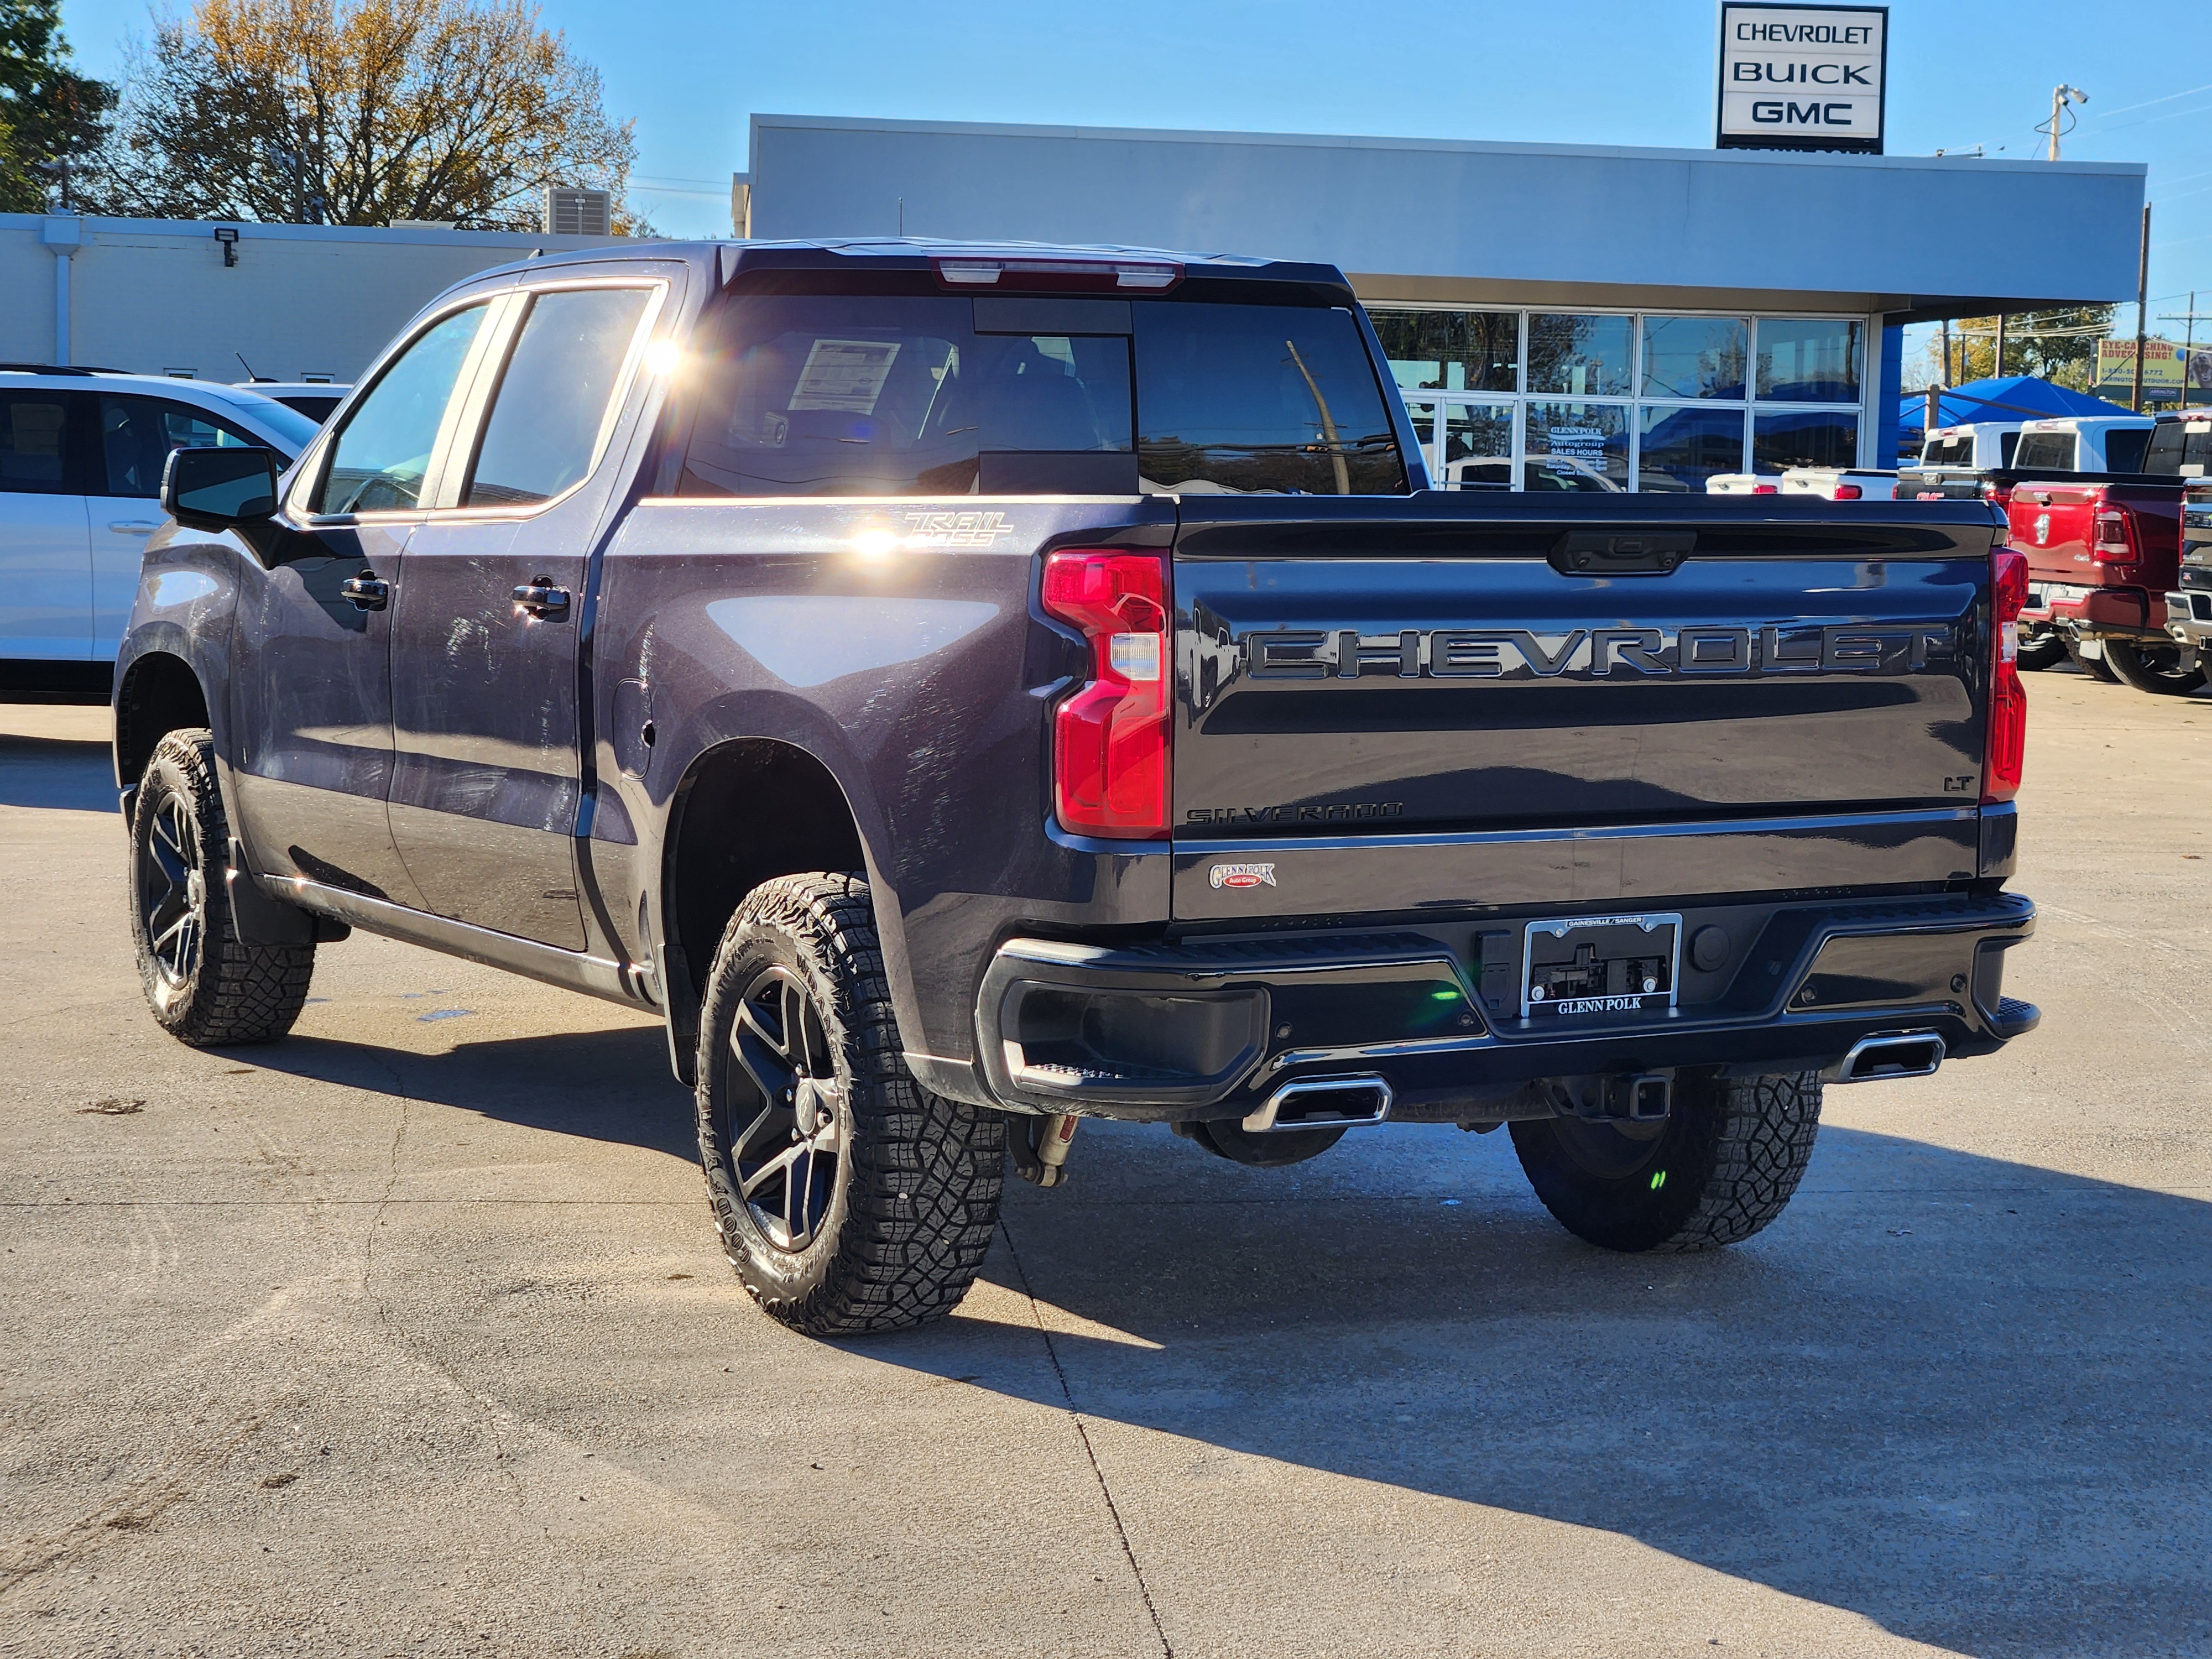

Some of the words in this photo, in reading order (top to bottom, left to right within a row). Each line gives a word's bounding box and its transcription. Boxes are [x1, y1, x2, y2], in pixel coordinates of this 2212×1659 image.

[1736, 23, 1873, 44] CHEVROLET
[1733, 62, 1874, 85] BUICK
[1752, 101, 1853, 126] GMC
[2102, 341, 2173, 351] EYE-CACHING
[2102, 349, 2171, 359] ADVERSING!
[904, 512, 1015, 533] TRAIL
[1247, 624, 1949, 680] CHEVROLET
[1943, 776, 1975, 792] LT
[1186, 802, 1404, 826] SILVERADO
[1212, 864, 1246, 886] GLENN
[1248, 865, 1275, 884] POLK
[1558, 1000, 1605, 1015] GLENN
[1605, 997, 1642, 1011] POLK
